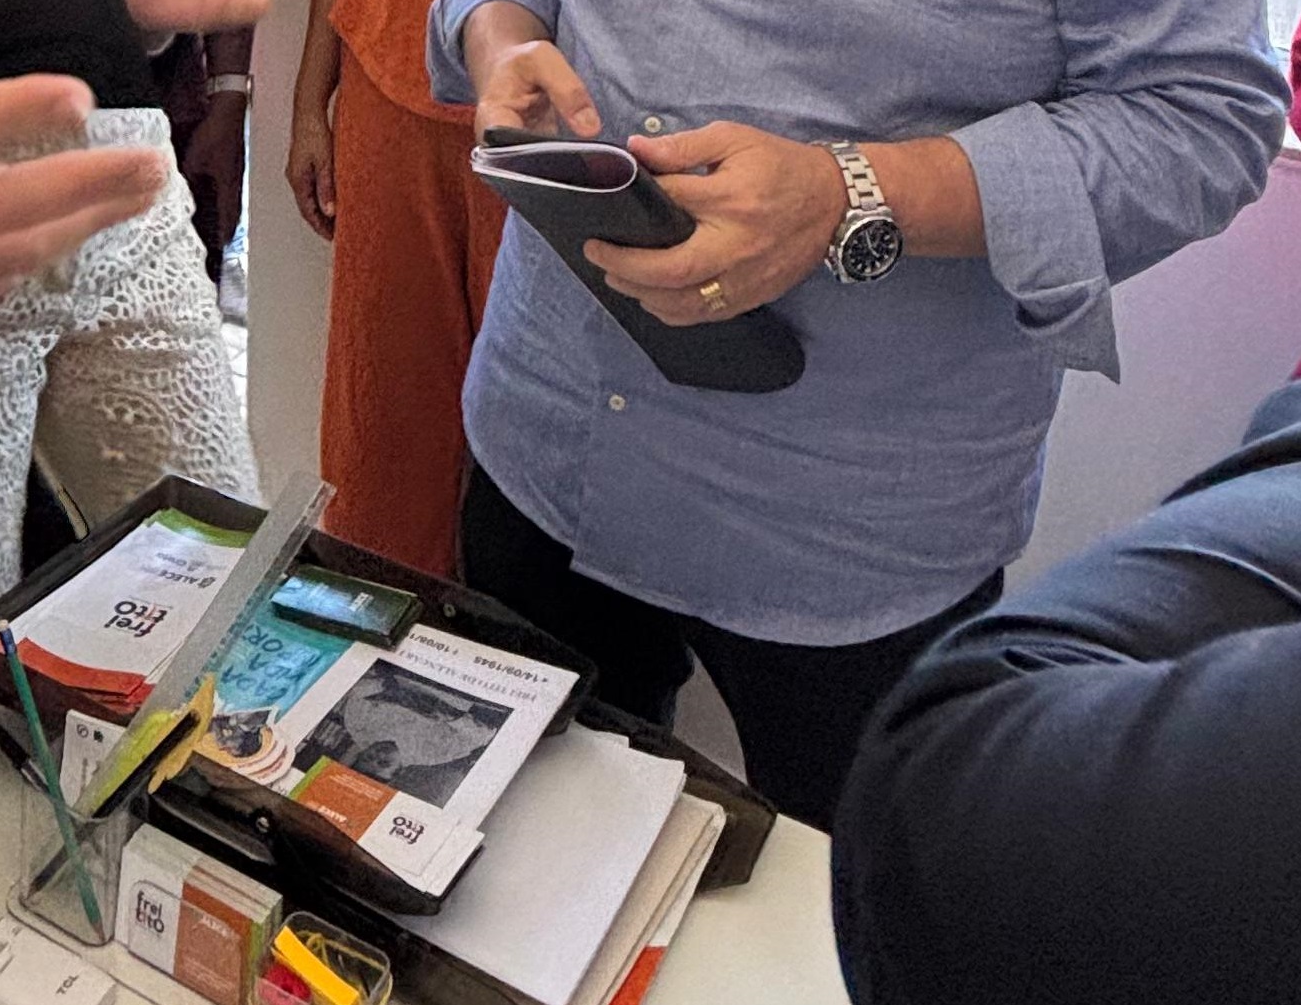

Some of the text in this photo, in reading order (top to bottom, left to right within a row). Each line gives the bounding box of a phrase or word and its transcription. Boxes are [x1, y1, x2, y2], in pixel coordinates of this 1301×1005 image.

[159, 570, 199, 585] ALECE
[104, 615, 156, 638] frei
[56, 974, 79, 996] TCL
